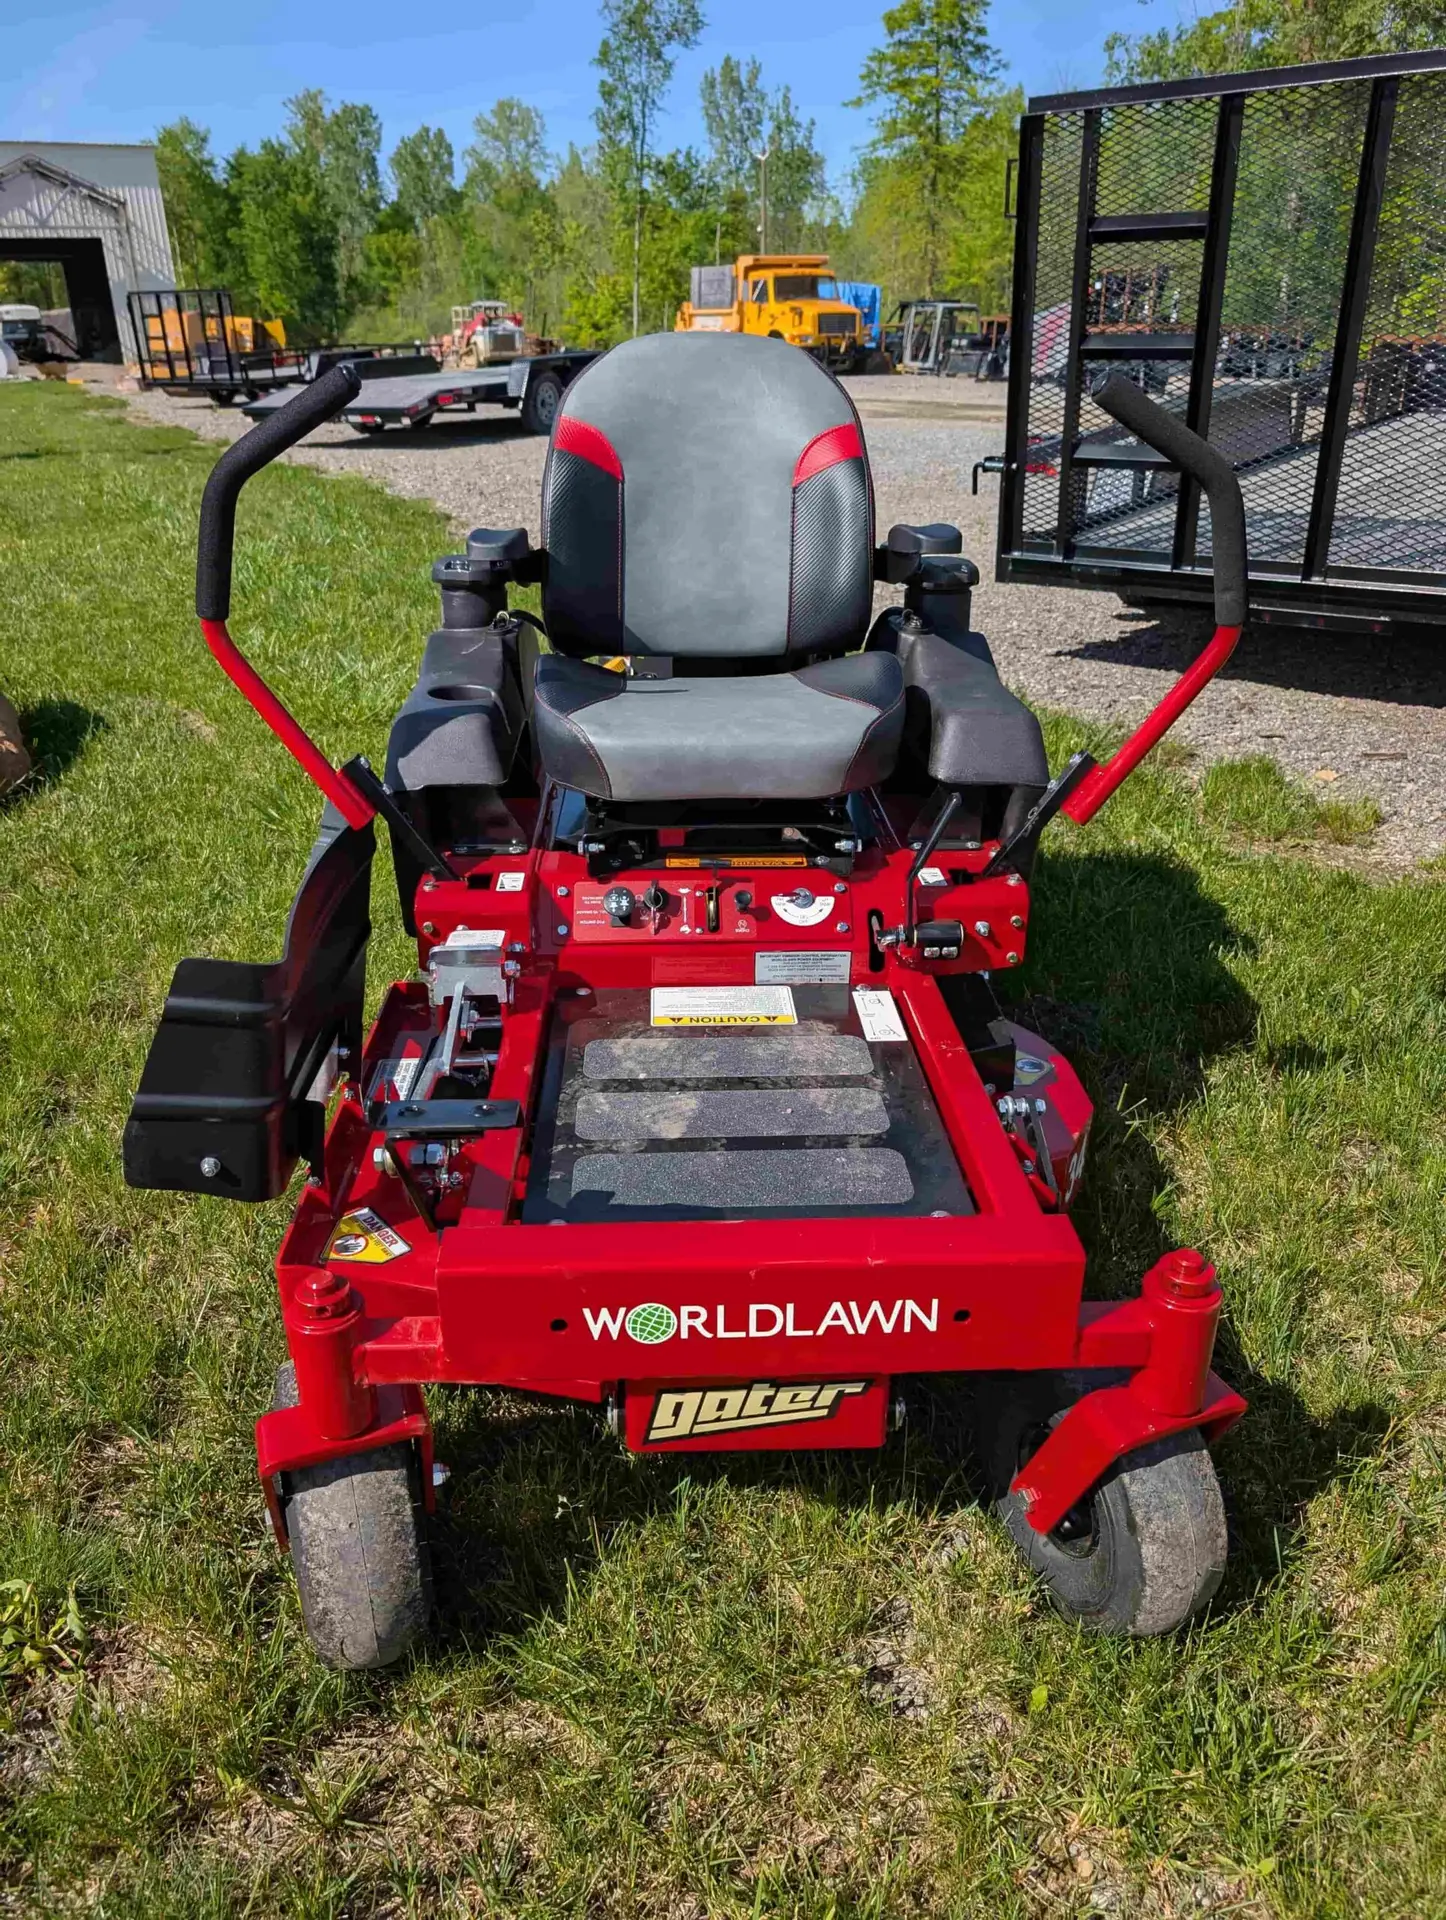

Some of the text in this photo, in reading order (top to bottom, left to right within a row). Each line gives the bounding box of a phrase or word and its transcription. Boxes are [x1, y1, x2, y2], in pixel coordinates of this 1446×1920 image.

[689, 1015, 760, 1023] CAUTION
[362, 1216, 399, 1247] DANGER
[582, 1299, 939, 1345] WORLDLAWN
